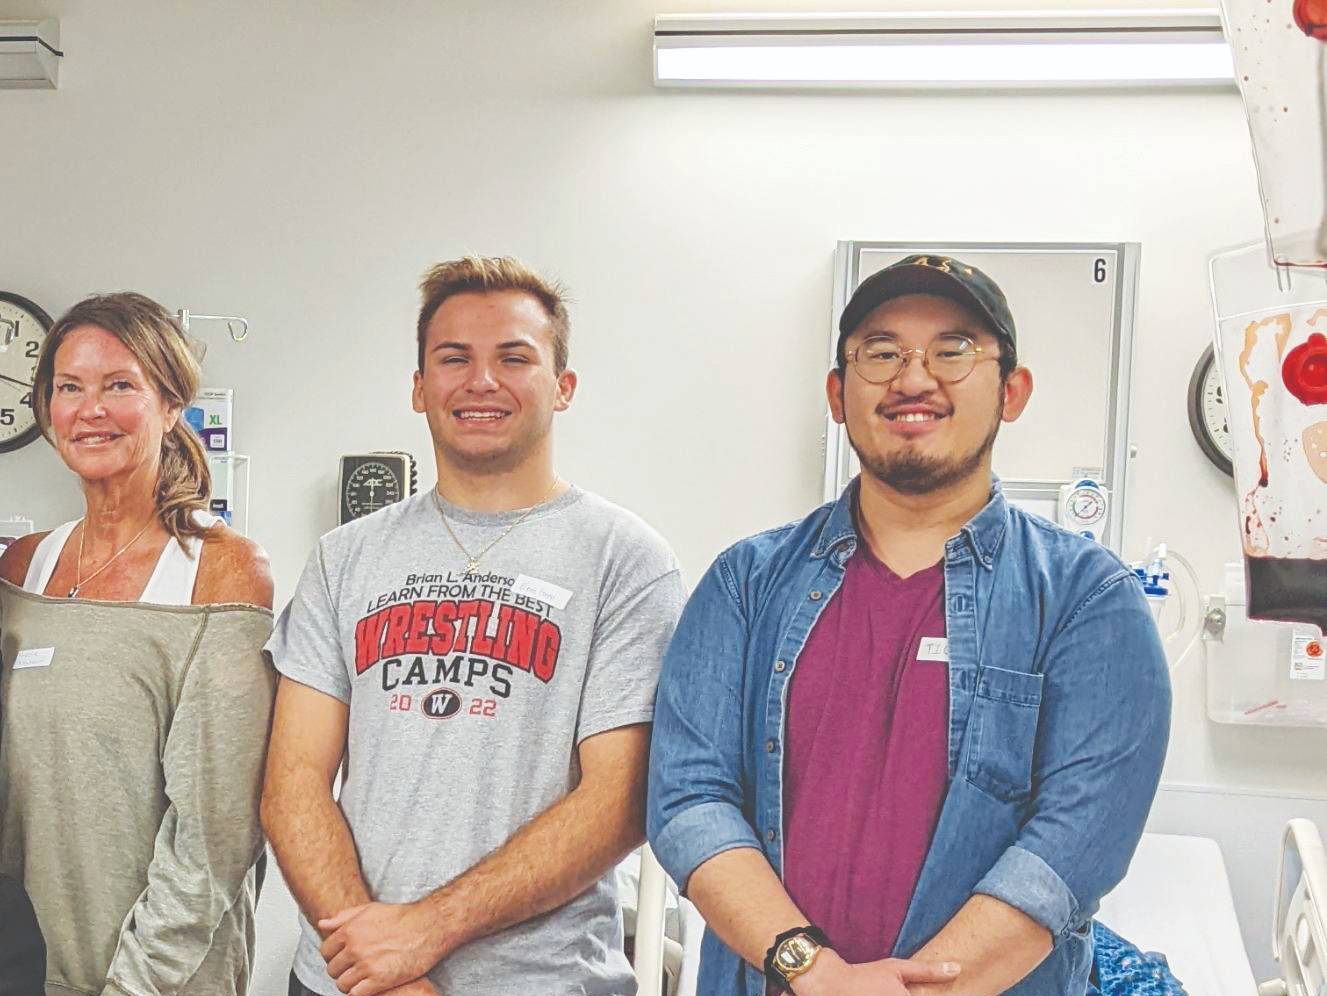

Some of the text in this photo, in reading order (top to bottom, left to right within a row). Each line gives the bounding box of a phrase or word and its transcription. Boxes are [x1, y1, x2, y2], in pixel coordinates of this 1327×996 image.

[1094, 258, 1106, 283] 6
[25, 341, 39, 358] 2
[0, 408, 15, 426] 5
[209, 414, 222, 425] XL
[406, 573, 443, 586] Brian
[461, 571, 516, 587] Anderso
[367, 586, 424, 613] LEARN
[427, 585, 478, 598] FROM
[481, 585, 512, 602] THE
[515, 592, 554, 617] BEST
[354, 599, 562, 684] WRESTLING
[382, 655, 514, 699] CAMPS
[390, 694, 412, 711] 20
[469, 698, 497, 717] 22
